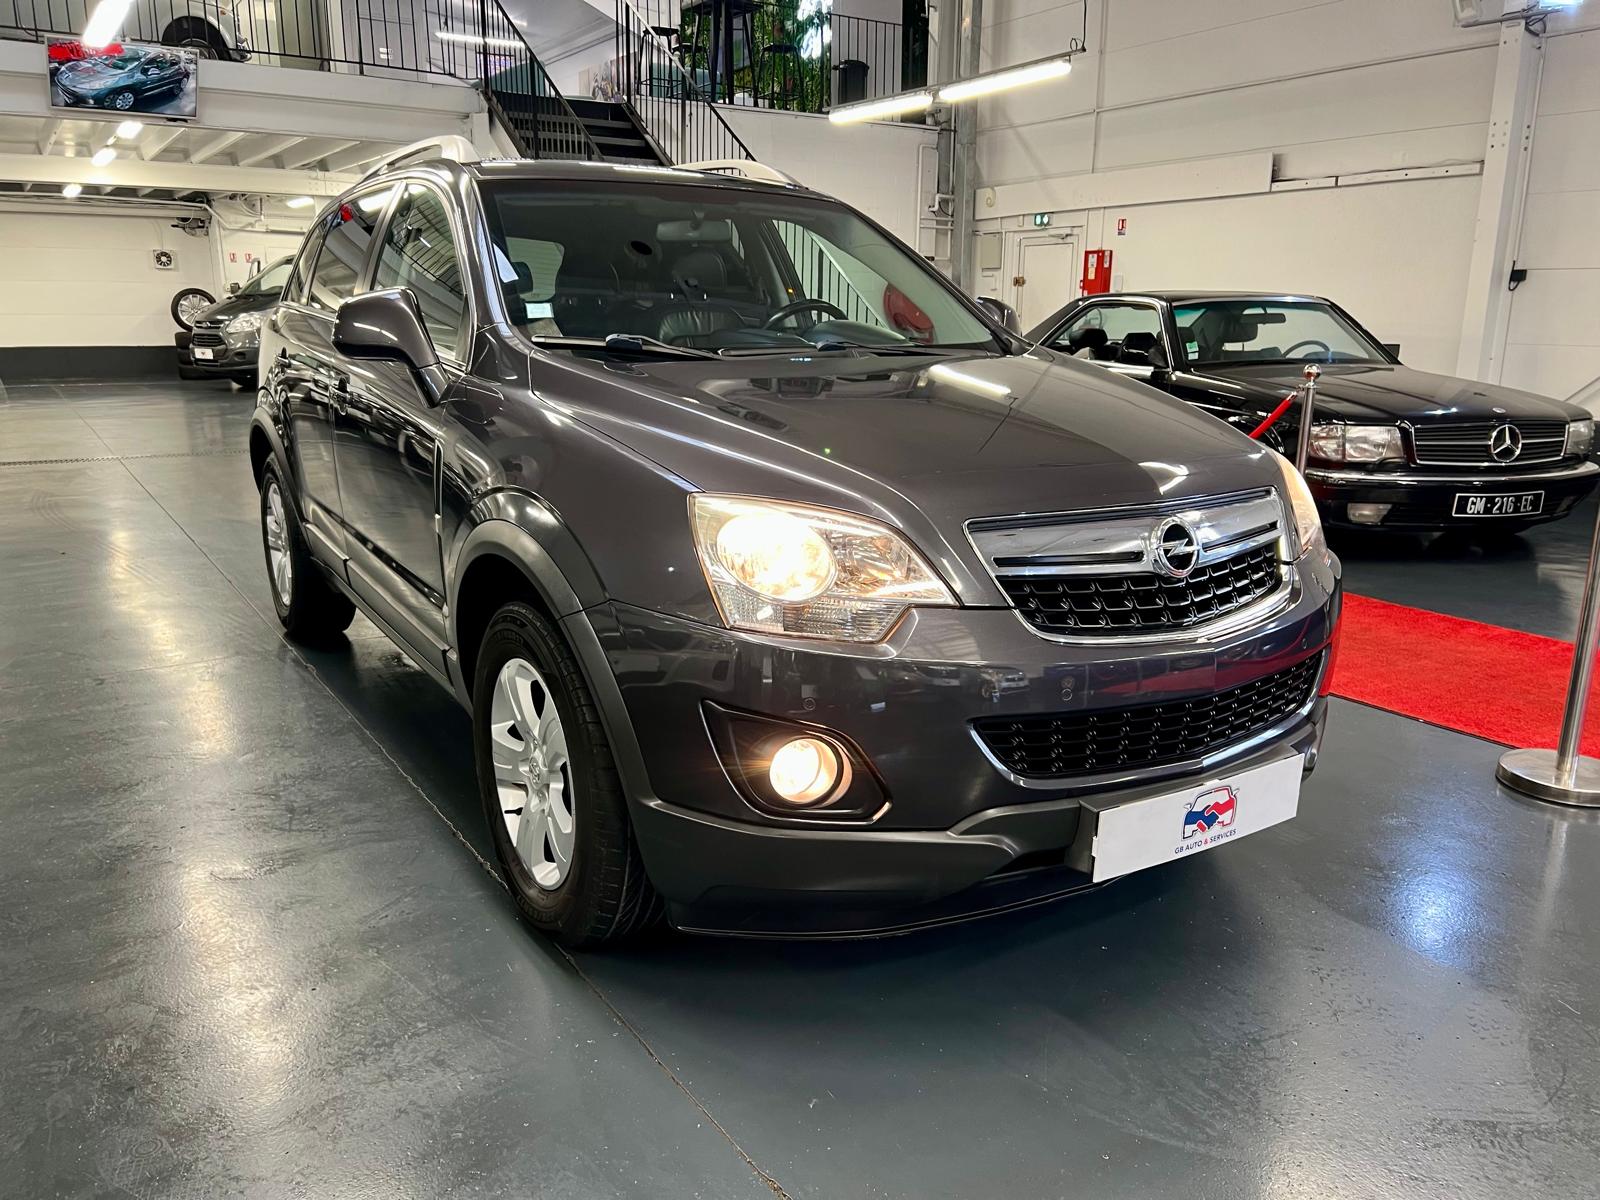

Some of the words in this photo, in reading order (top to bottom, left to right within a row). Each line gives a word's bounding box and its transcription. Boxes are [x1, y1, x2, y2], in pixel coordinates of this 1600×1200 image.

[1174, 846, 1184, 854] GB
[1185, 840, 1202, 851] AUTO
[1210, 829, 1236, 843] SERVICES
